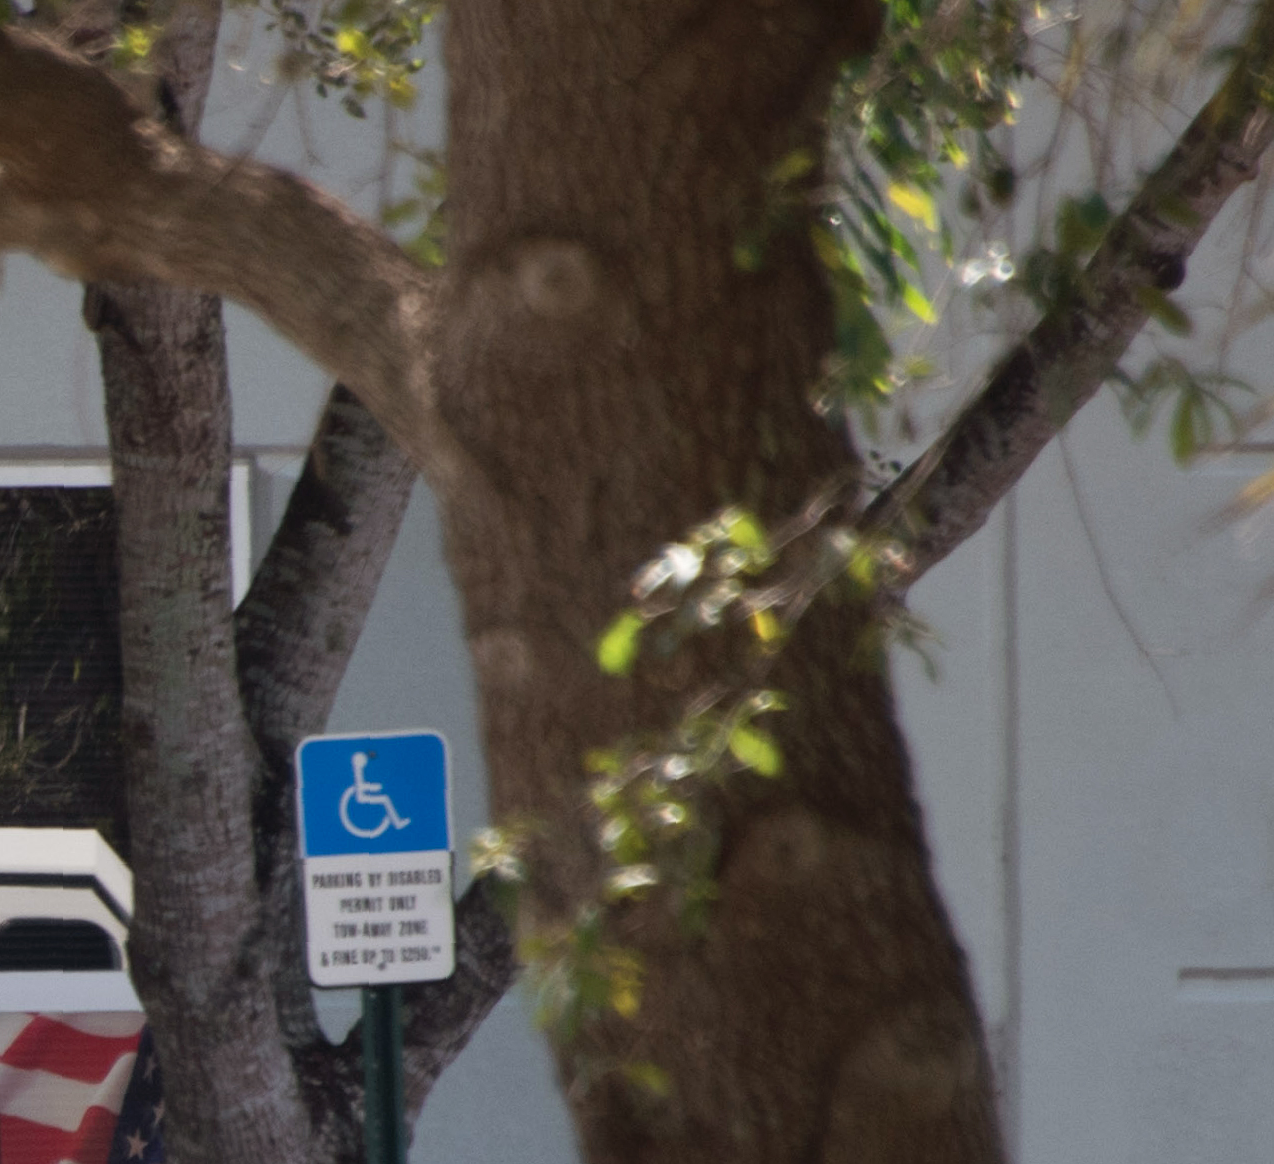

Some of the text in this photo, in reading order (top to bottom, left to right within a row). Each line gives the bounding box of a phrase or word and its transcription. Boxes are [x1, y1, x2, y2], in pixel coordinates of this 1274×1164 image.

[312, 869, 442, 889] PARKING BY DISABLED
[339, 895, 418, 913] PERMIT ONLY
[399, 919, 428, 937] ZONE
[320, 951, 329, 968] &
[332, 949, 359, 966] FINE
[362, 948, 377, 964] UP
[381, 947, 395, 963] TO
